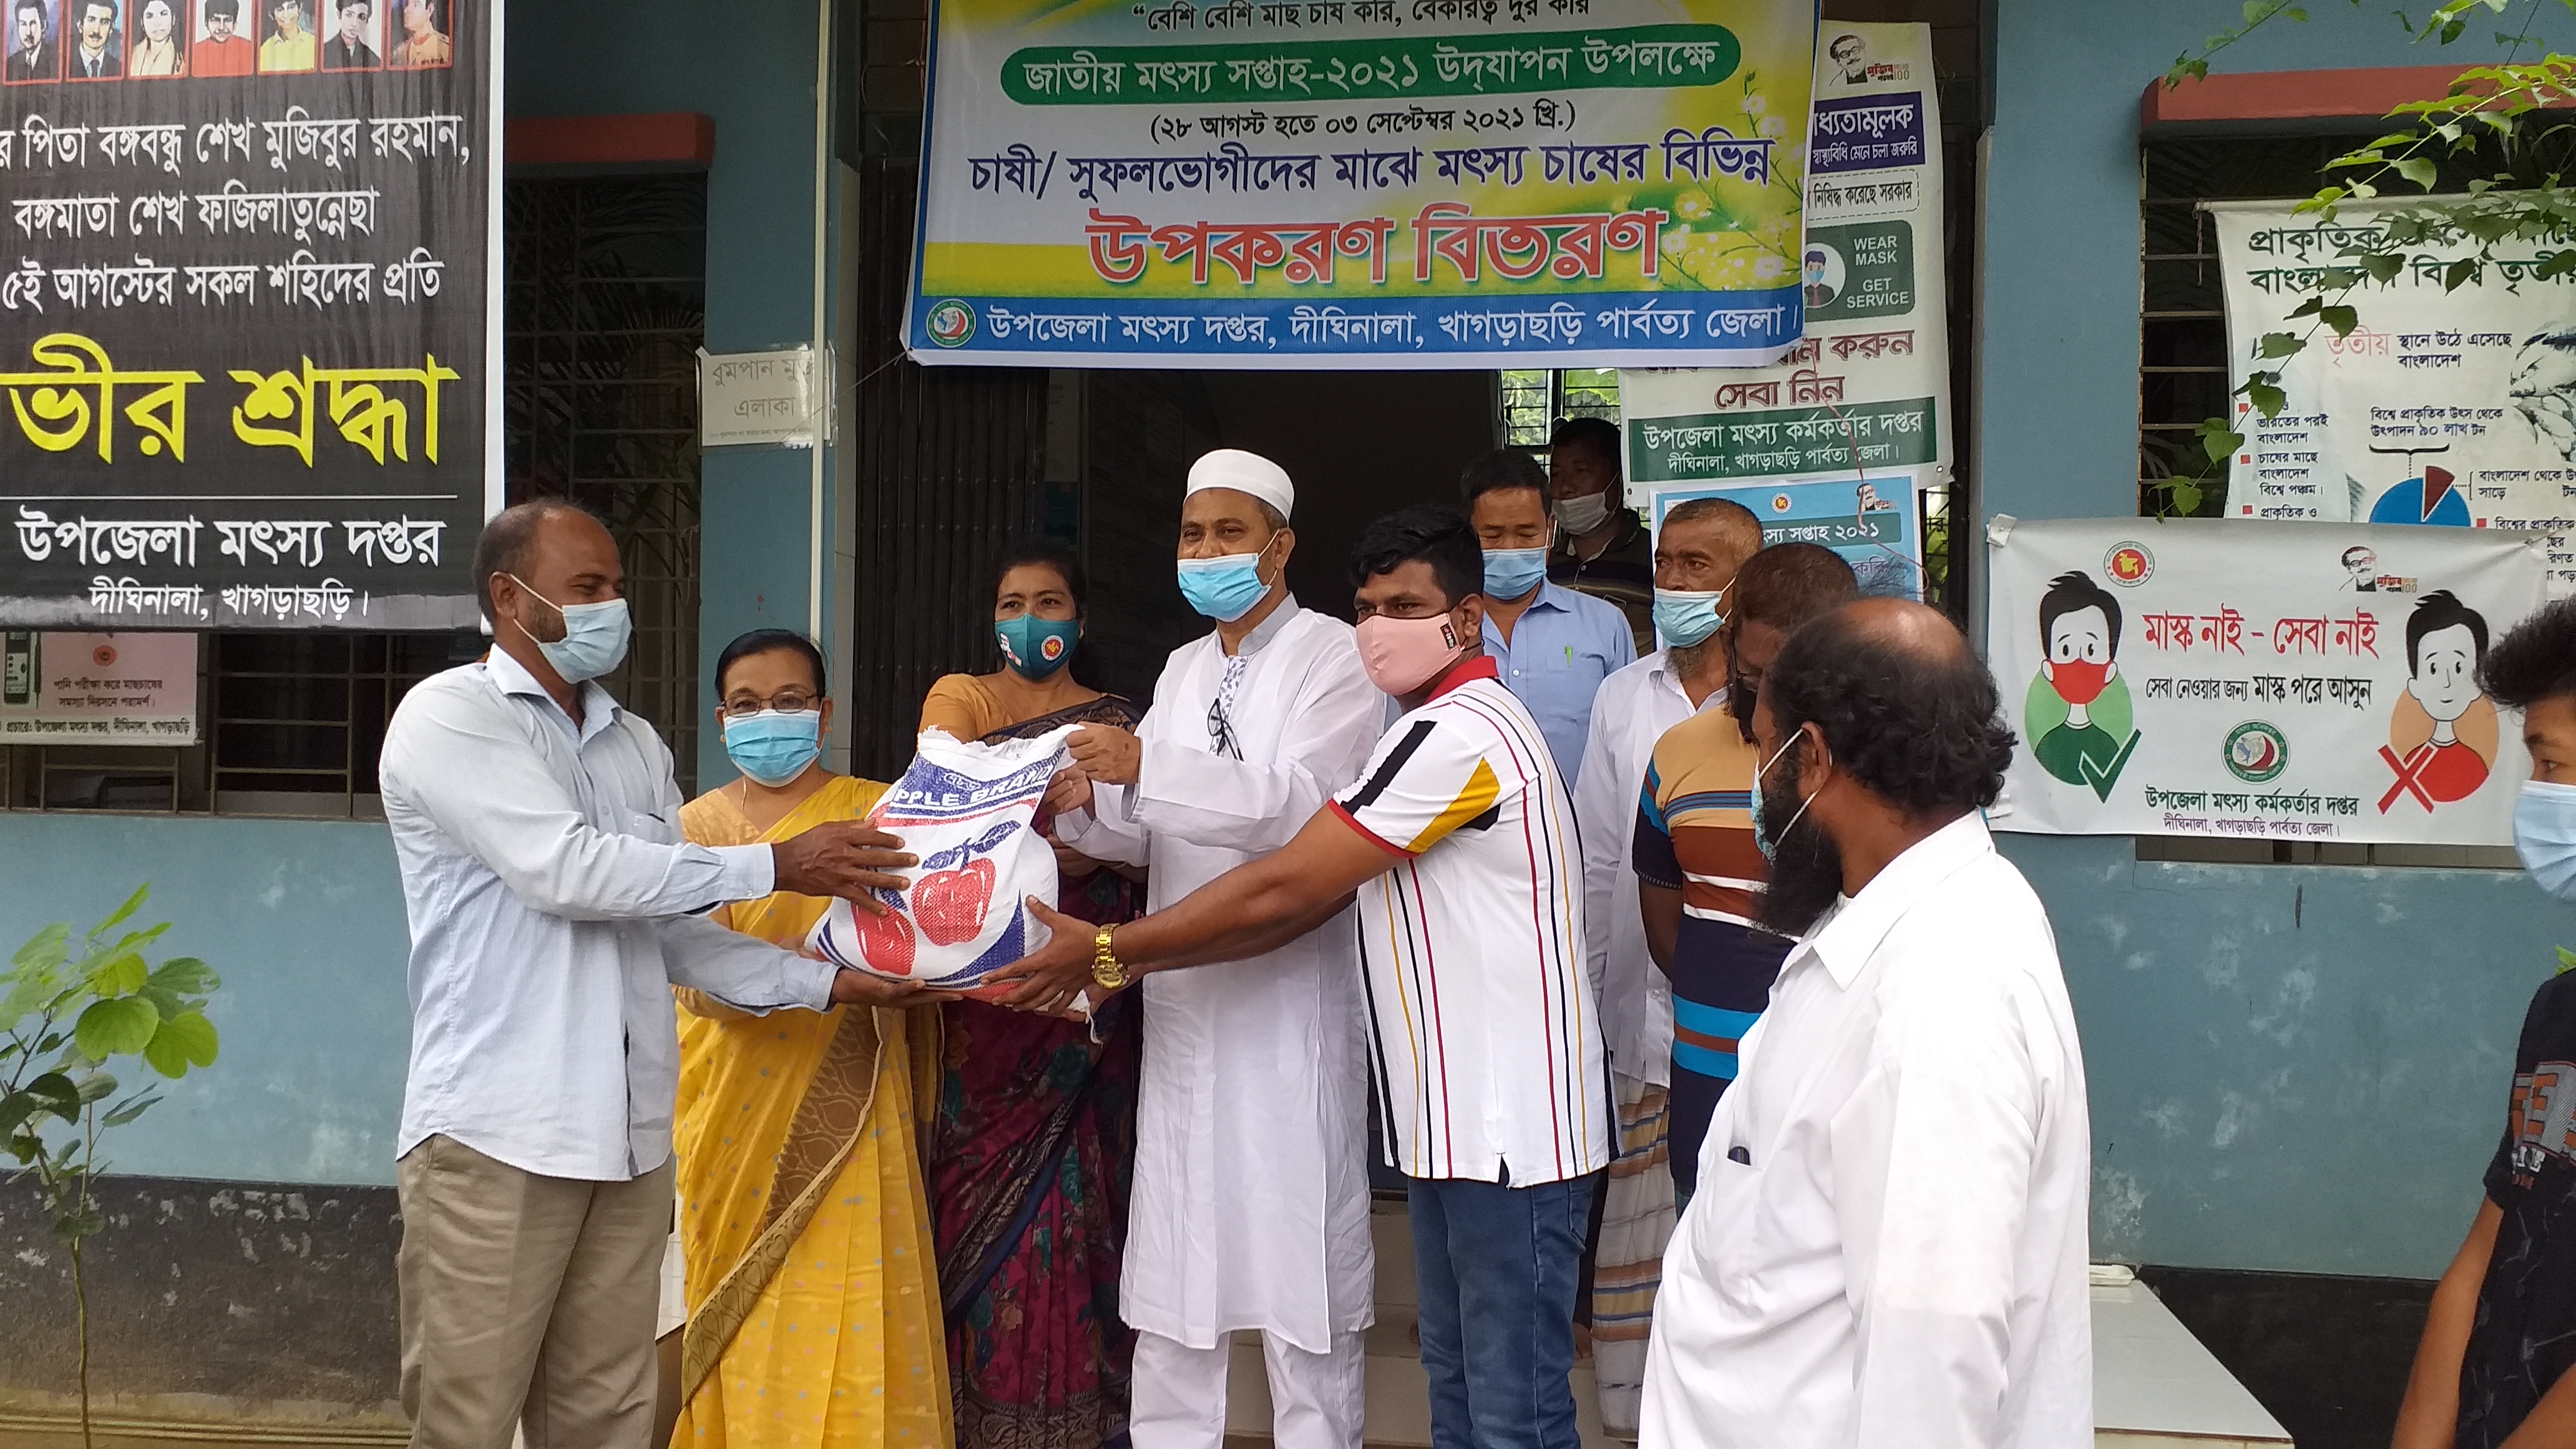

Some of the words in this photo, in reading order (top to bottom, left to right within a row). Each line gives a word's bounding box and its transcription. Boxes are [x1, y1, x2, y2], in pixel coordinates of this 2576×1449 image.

[1261, 1, 1302, 29] মাছ
[1023, 50, 1125, 95] জাতীয়
[1134, 60, 1217, 94] মৎস্য
[1581, 35, 1721, 76] উপলক্ষে
[1199, 109, 1269, 139] আগস্ট
[1273, 114, 1319, 139] হতে
[1325, 116, 1359, 134] ০৩
[1367, 104, 1456, 135] সেপ্টেম্বর
[1463, 107, 1524, 133] ২০২১
[1813, 104, 1914, 139] াধ্যতামূলক
[22, 114, 90, 168] পিতা
[97, 124, 186, 177] বঙ্গবন্ধু
[195, 117, 255, 163] শেখ
[262, 105, 361, 172] মুজিবুর
[368, 110, 470, 166] রহমান,
[1850, 145, 1870, 160] মেনে
[1872, 143, 1889, 159] চলা
[968, 144, 1057, 200] চাষী/
[1066, 142, 1322, 203] সুফলভোগীদের
[1330, 147, 1424, 192] মাঝে
[1432, 145, 1531, 187] মৎস্য
[1538, 139, 1651, 185] চাষের
[1661, 127, 1776, 187] বিভিন্ন
[1845, 185, 1878, 205] করেছে
[1879, 179, 1913, 202] সরকার
[12, 191, 120, 240] বঙ্গমাতা
[129, 190, 187, 236] শেখ
[195, 178, 379, 245] ফজিলাতুন্নেছা
[1085, 207, 1395, 285] উপকরণ
[1412, 201, 1669, 282] বিতরণ
[1854, 235, 1898, 251] WEAR
[1855, 250, 1898, 266] MASK
[52, 255, 177, 310] আগস্টের
[185, 263, 257, 307] সকল
[266, 250, 376, 305] শহিদের
[383, 248, 445, 305] প্রতি
[1862, 277, 1892, 293] GET
[1847, 291, 1910, 310] SERVICE
[988, 306, 1112, 344] উপজেলা
[1118, 314, 1195, 344] মৎস্য
[1203, 313, 1276, 349] দপ্তর,
[1288, 306, 1425, 349] দীঘিনালা,
[1438, 302, 1586, 347] খাগড়াছড়ি
[1595, 299, 1695, 341] পার্বত্য
[2436, 328, 2461, 347] উঠে
[2467, 331, 2512, 348] এসেছে
[1828, 329, 1915, 361] করুন
[2397, 354, 2462, 369] বাংলাদেশ
[0, 333, 206, 464] ভীর
[227, 351, 461, 468] শ্রদ্ধা
[1714, 381, 1781, 409] সেবা
[1787, 369, 1845, 406] নিন
[734, 397, 796, 419] এলাকা
[2449, 405, 2472, 420] উৎস
[2476, 408, 2504, 420] থেকে
[1642, 422, 1724, 451] উপজেলা
[1728, 422, 1779, 447] মৎস্য
[1784, 408, 1873, 444] কর্মকর্তার
[1878, 409, 1925, 436] দপ্তর
[2257, 432, 2308, 444] বাংলাদেশ
[2471, 424, 2486, 436] টন
[1667, 452, 1729, 475] দীঘিনালা,
[1734, 446, 1802, 472] খাগড়াছড়ি
[1805, 442, 1850, 466] পার্বত্য
[2258, 452, 2290, 464] চাষের
[2293, 452, 2318, 464] মাছে
[2258, 468, 2310, 480] বাংলাদেশ
[2479, 470, 2530, 482] বাংলাদেশ
[2534, 470, 2562, 482] থেকে
[2260, 504, 2304, 520] প্রাকৃতিক
[2308, 509, 2317, 517] ও
[14, 504, 203, 567] উপজেলা
[213, 520, 332, 567] মৎস্য
[342, 514, 447, 567] দপ্তর
[1788, 525, 1830, 542] সপ্তাহ
[1835, 522, 1880, 542] ২০২১
[87, 575, 209, 620] দীঘিনালা,
[2142, 610, 2195, 653] মাস্ক
[2200, 602, 2245, 656] নাই
[2273, 614, 2329, 656] সেবা
[2334, 606, 2379, 660] নাই
[2146, 676, 2173, 699] সেবা
[2176, 677, 2220, 701] নেওয়ার
[2223, 680, 2248, 701] জন্য
[2253, 673, 2286, 704] মাস্ক
[2291, 674, 2324, 704] পরে
[2326, 676, 2373, 711] আসুন
[894, 788, 959, 806] PPLE
[2145, 784, 2208, 811] উপজেলা
[2212, 791, 2250, 812] মৎস্য
[2253, 788, 2321, 815] কর্মকর্তার
[2326, 796, 2359, 817] দপ্তর
[2164, 812, 2212, 835] দীঘিনালা,
[2269, 817, 2303, 836] পার্বত্য
